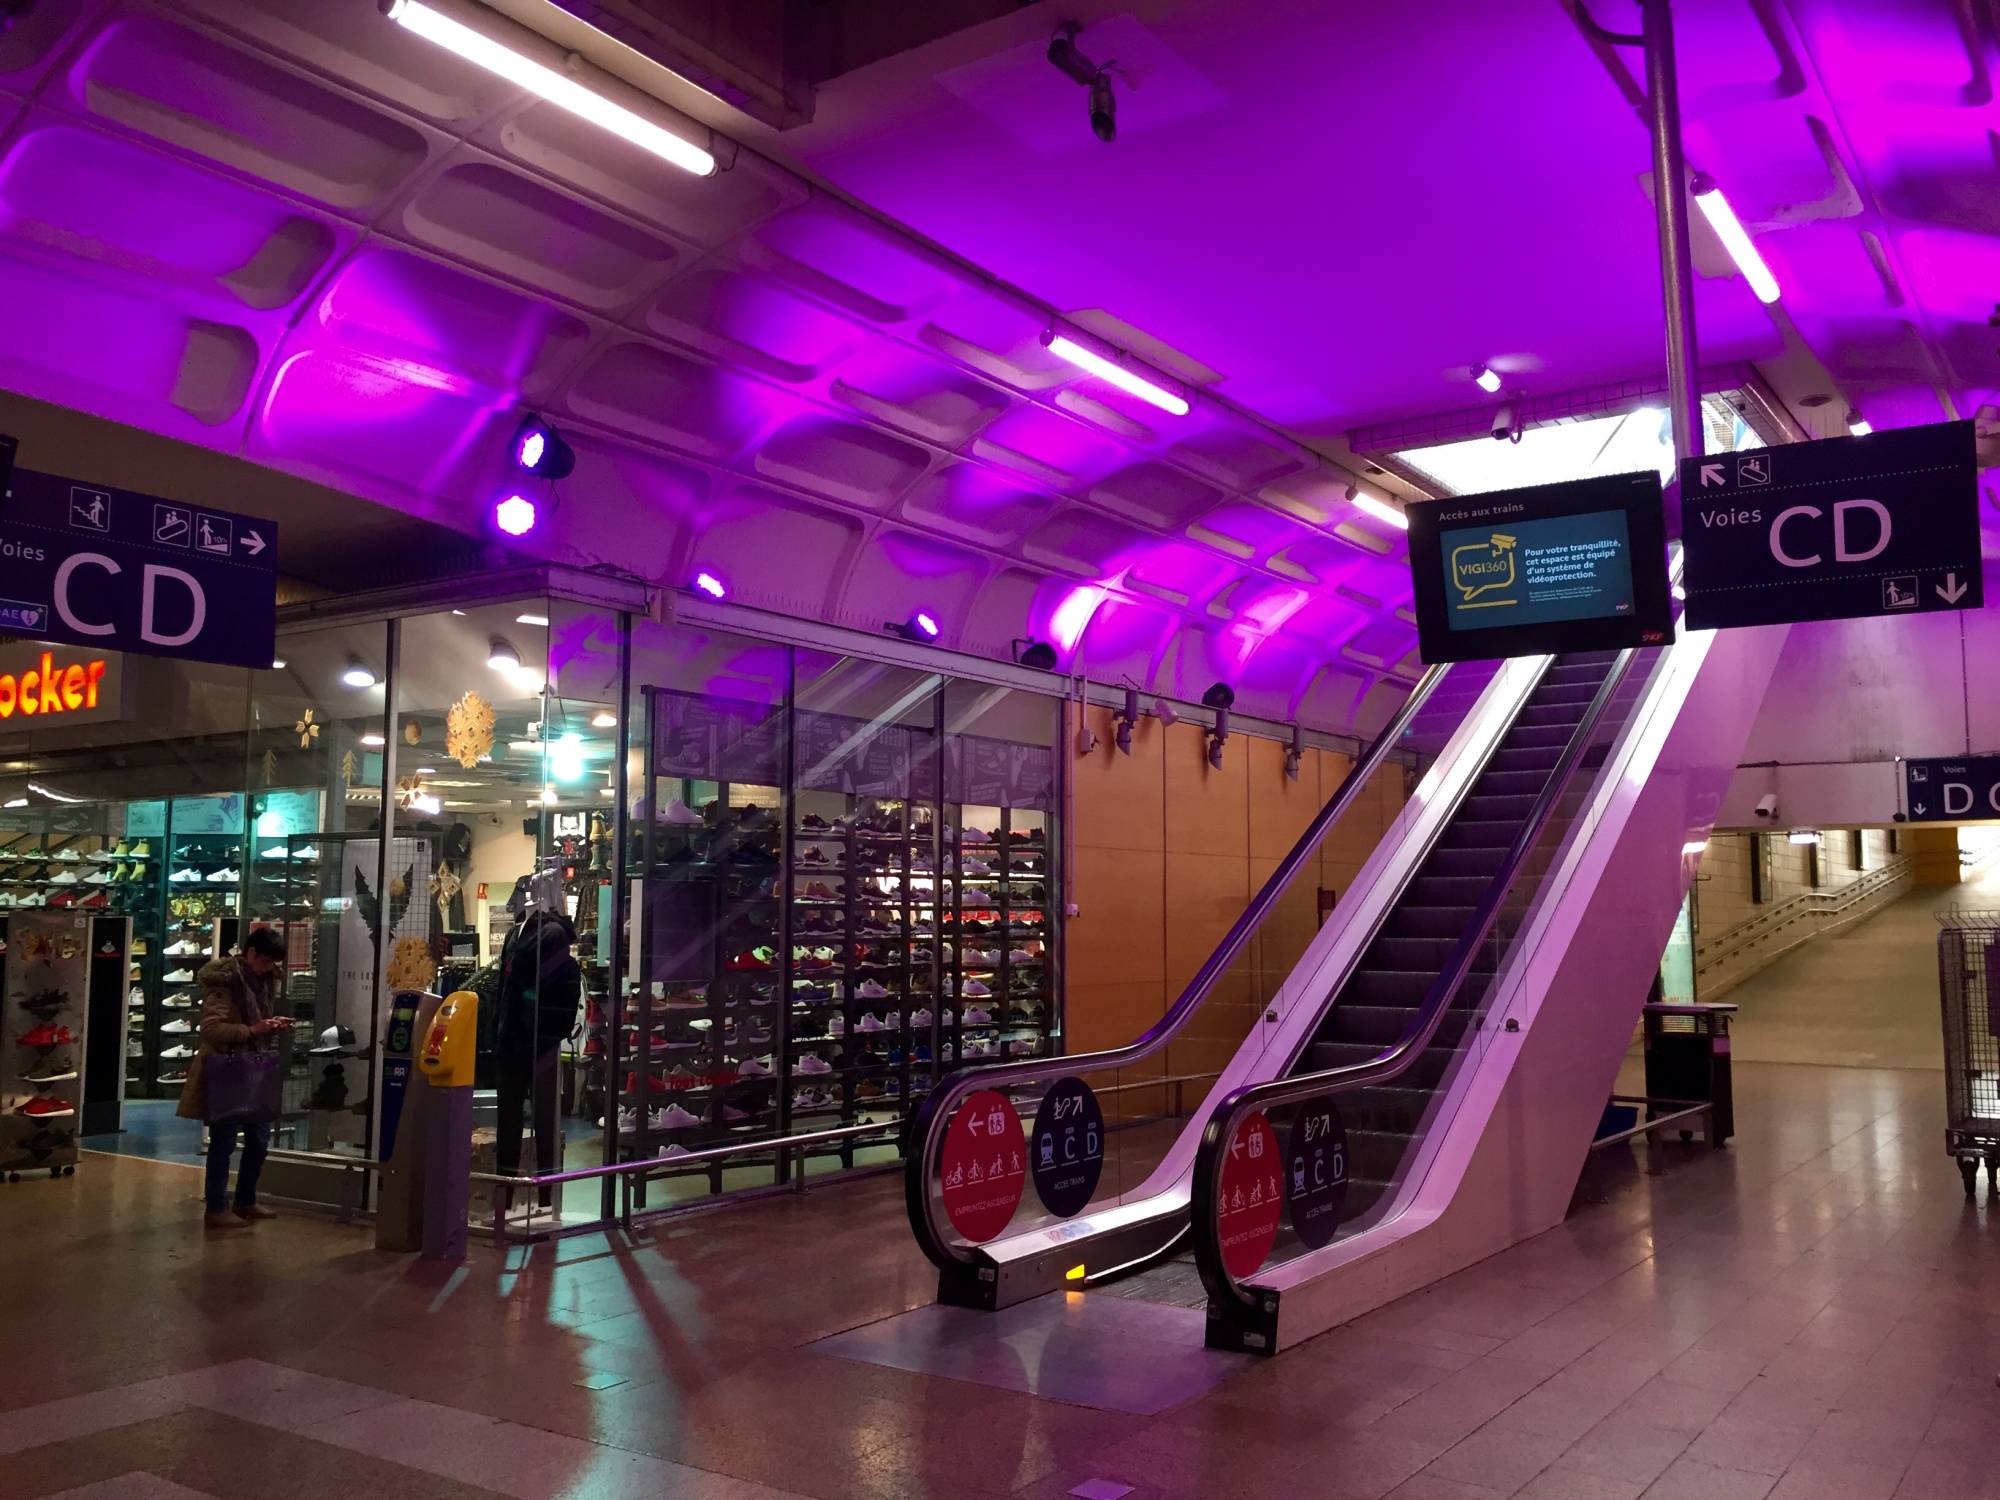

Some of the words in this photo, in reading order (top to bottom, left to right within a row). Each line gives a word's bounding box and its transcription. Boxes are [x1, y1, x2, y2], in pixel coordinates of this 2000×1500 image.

[1439, 510, 1469, 521] Accès
[1471, 508, 1490, 517] aux
[1493, 503, 1525, 514] trains
[1700, 507, 1762, 528] Voies
[1525, 548, 1544, 557] Pour
[1546, 546, 1568, 555] votre
[1526, 558, 1539, 566] cet
[1541, 555, 1569, 566] espace
[1571, 553, 1585, 561] est
[1587, 549, 1616, 561] équipé
[1459, 560, 1507, 575] VIGI360
[1527, 566, 1545, 575] d'un
[1547, 563, 1581, 575] système
[1583, 561, 1594, 569] de
[1527, 571, 1597, 584] vidéoprotection.
[0, 608, 19, 619] AE
[1942, 765, 1967, 774] Voies
[1944, 783, 1974, 814] D
[1065, 1135, 1076, 1160] C
[1087, 1131, 1098, 1155] D
[1313, 1158, 1324, 1186] C
[1333, 1152, 1344, 1180] D
